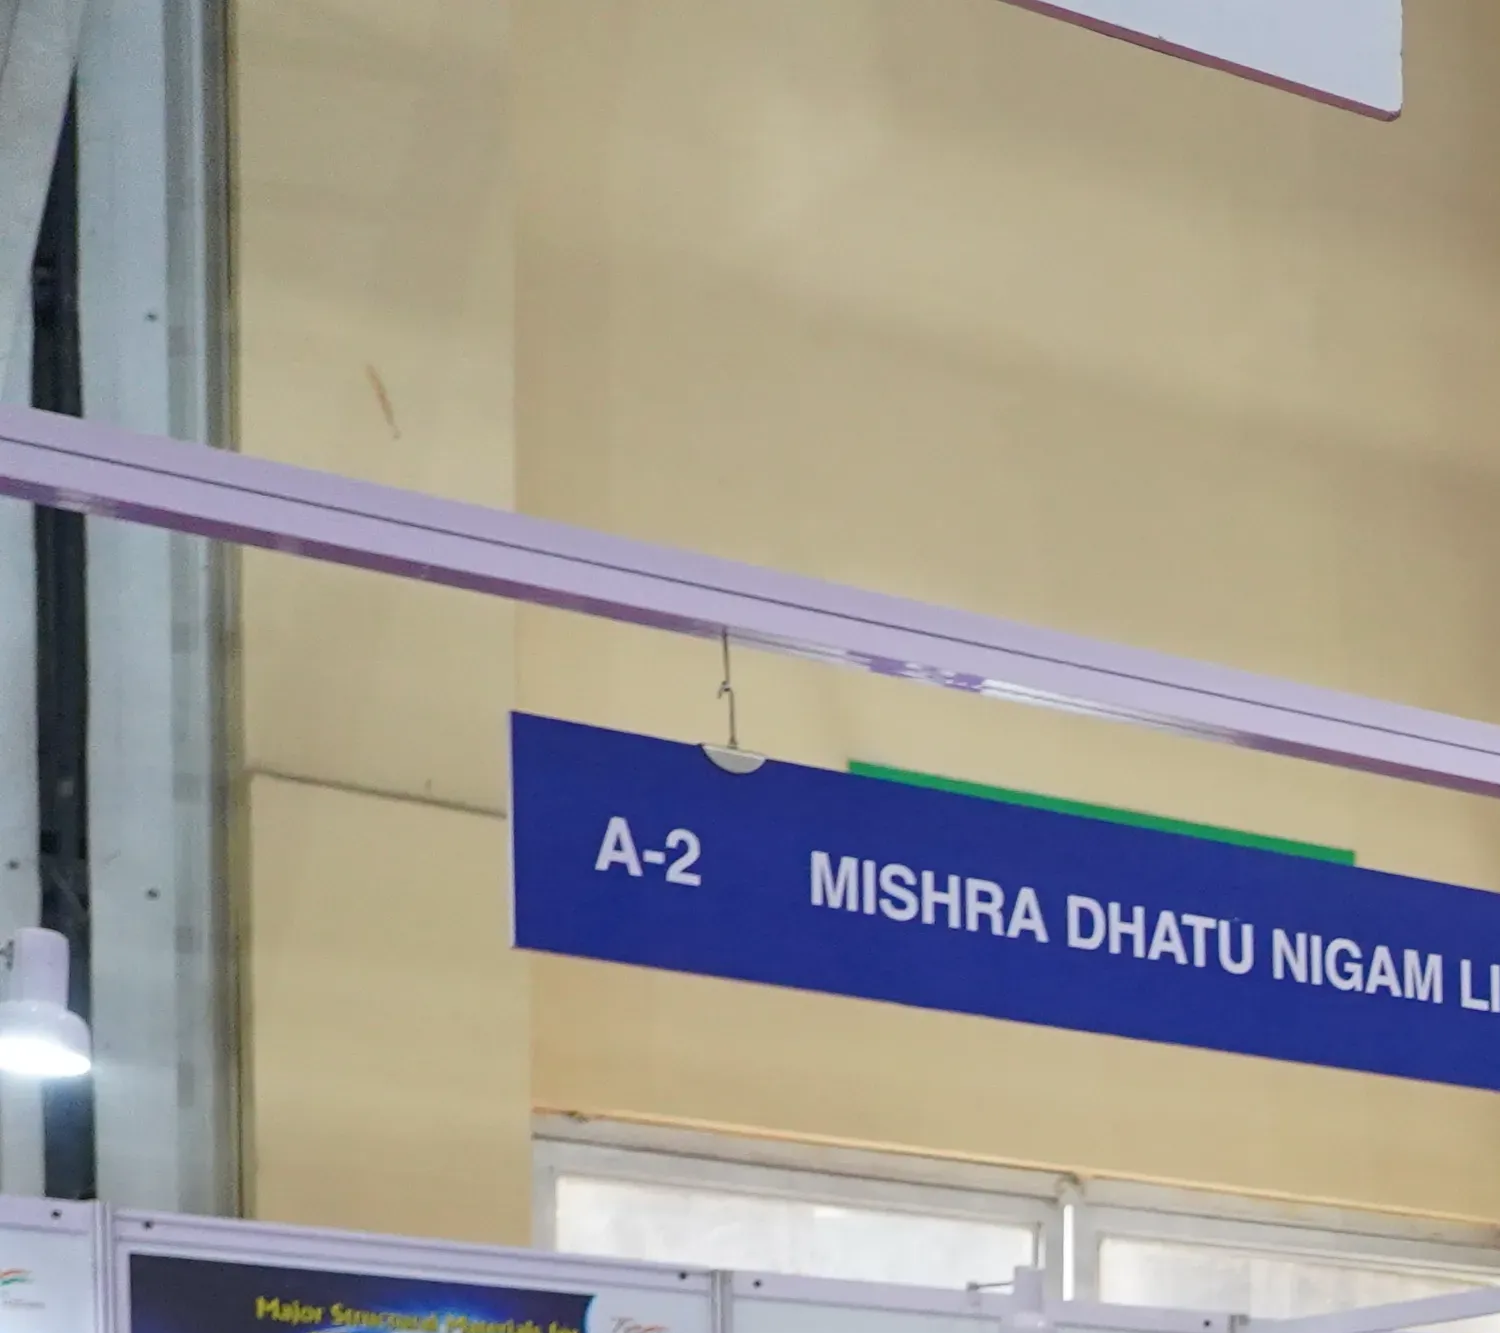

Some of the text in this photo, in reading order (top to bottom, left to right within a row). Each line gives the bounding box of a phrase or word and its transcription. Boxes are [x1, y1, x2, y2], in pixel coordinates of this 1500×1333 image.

[593, 815, 702, 889] A-2
[809, 850, 1051, 945] MISHRA
[1065, 895, 1256, 976] DHATU
[1271, 928, 1446, 1006] NIGAM
[255, 1296, 323, 1327] Major
